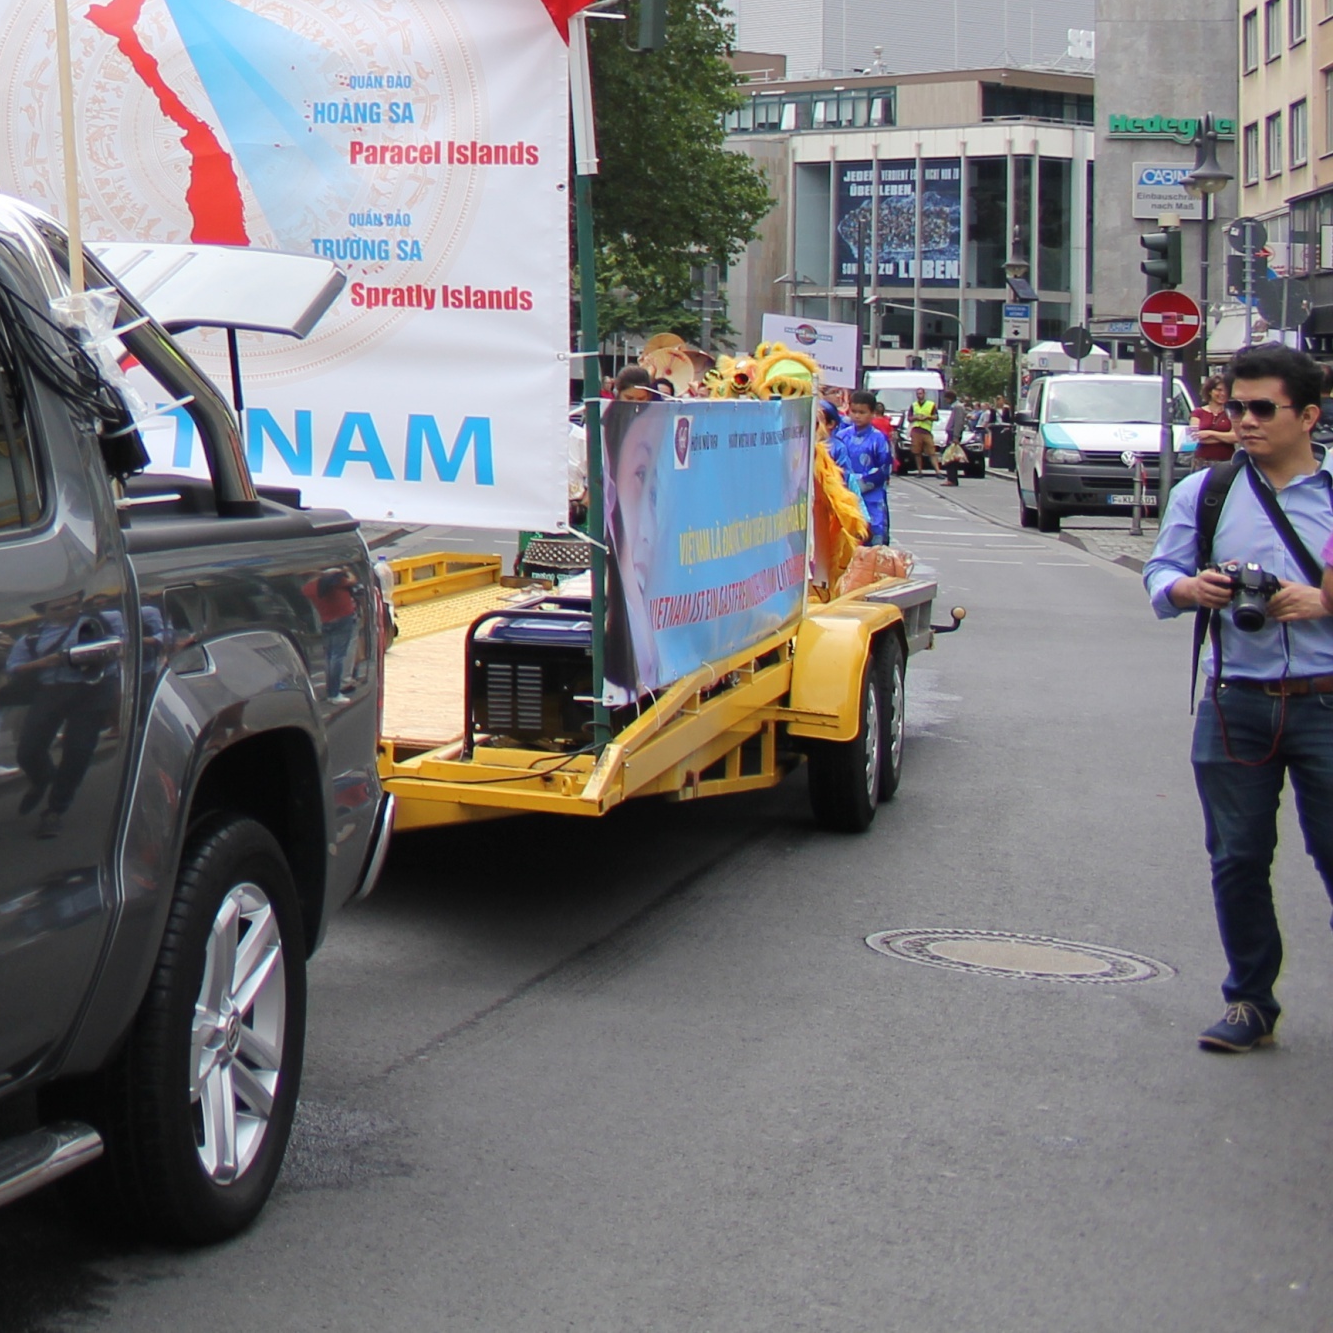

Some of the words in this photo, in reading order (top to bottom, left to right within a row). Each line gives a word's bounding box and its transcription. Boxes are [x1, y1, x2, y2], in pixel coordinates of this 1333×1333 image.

[313, 98, 381, 124] HOÀNG
[388, 102, 415, 124] SA
[350, 141, 441, 165] Paracel
[448, 141, 539, 165] Islands
[1151, 202, 1173, 210] nach
[396, 239, 423, 261] SA
[351, 282, 436, 310] Spratly
[443, 284, 534, 310] Islands
[649, 593, 691, 630] VIETNAM
